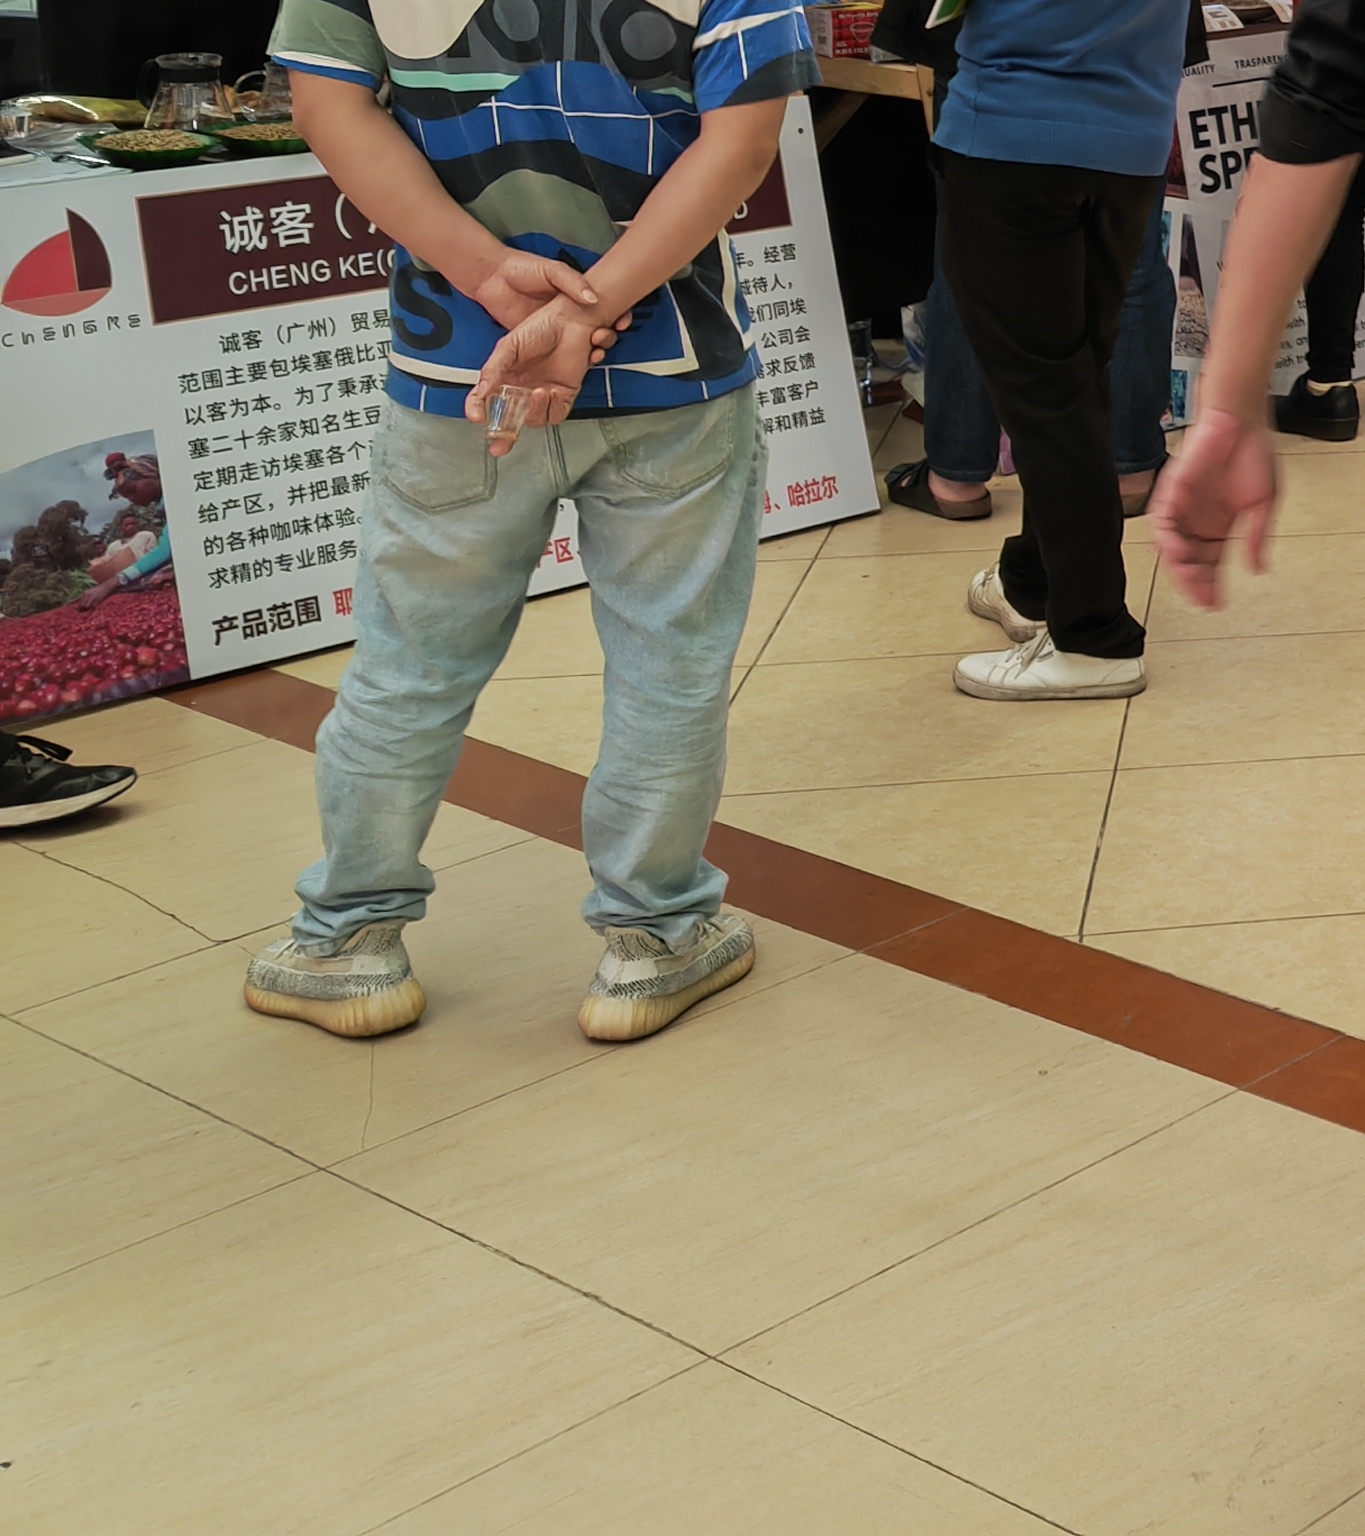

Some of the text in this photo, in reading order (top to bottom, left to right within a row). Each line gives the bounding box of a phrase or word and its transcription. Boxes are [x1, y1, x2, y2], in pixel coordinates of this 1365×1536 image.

[1188, 100, 1264, 149] ETH
[219, 192, 378, 255] 诚客（
[228, 257, 332, 296] CHENG
[187, 404, 383, 460] 塞二十余家知名生豆
[194, 441, 375, 492] 定期走访埃塞各个
[211, 595, 322, 646] 产品范围
